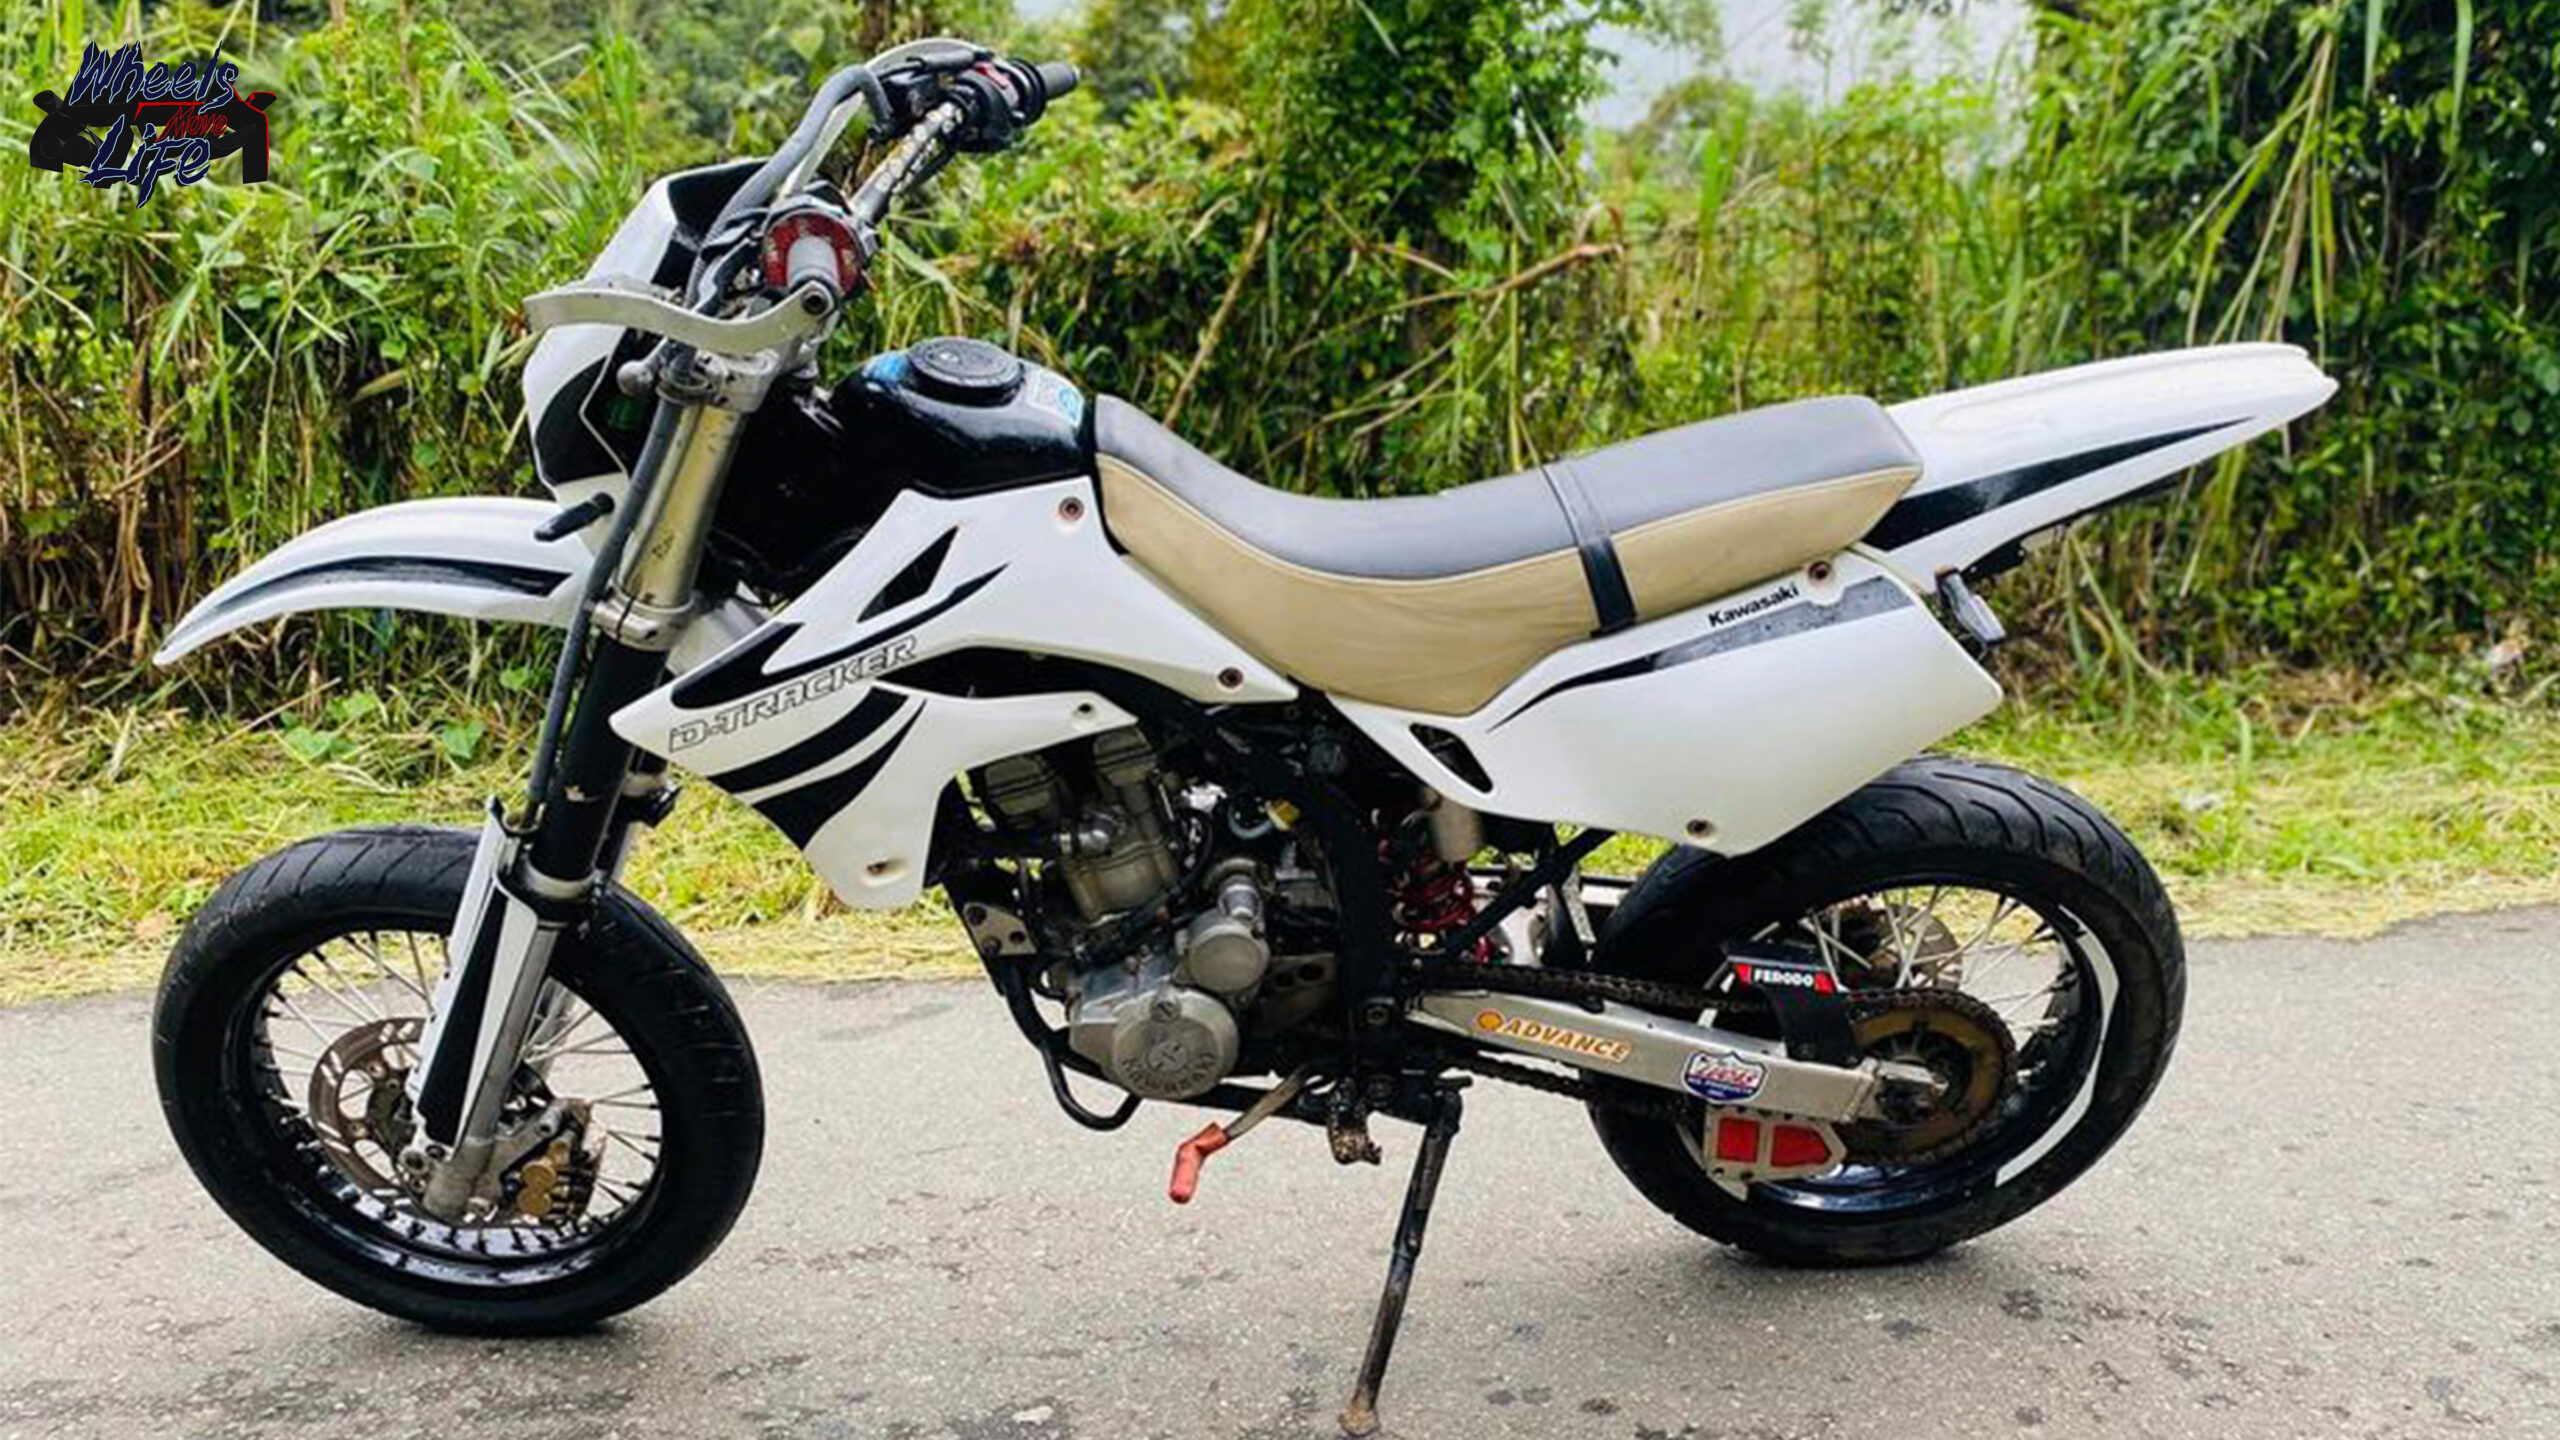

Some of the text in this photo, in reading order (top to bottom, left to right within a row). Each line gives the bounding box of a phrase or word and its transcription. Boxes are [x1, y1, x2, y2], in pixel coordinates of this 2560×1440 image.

[1708, 582, 1799, 627] Kawasaki
[669, 635, 917, 752] D-TRACKER
[1503, 1017, 1628, 1060] ADVANCE
